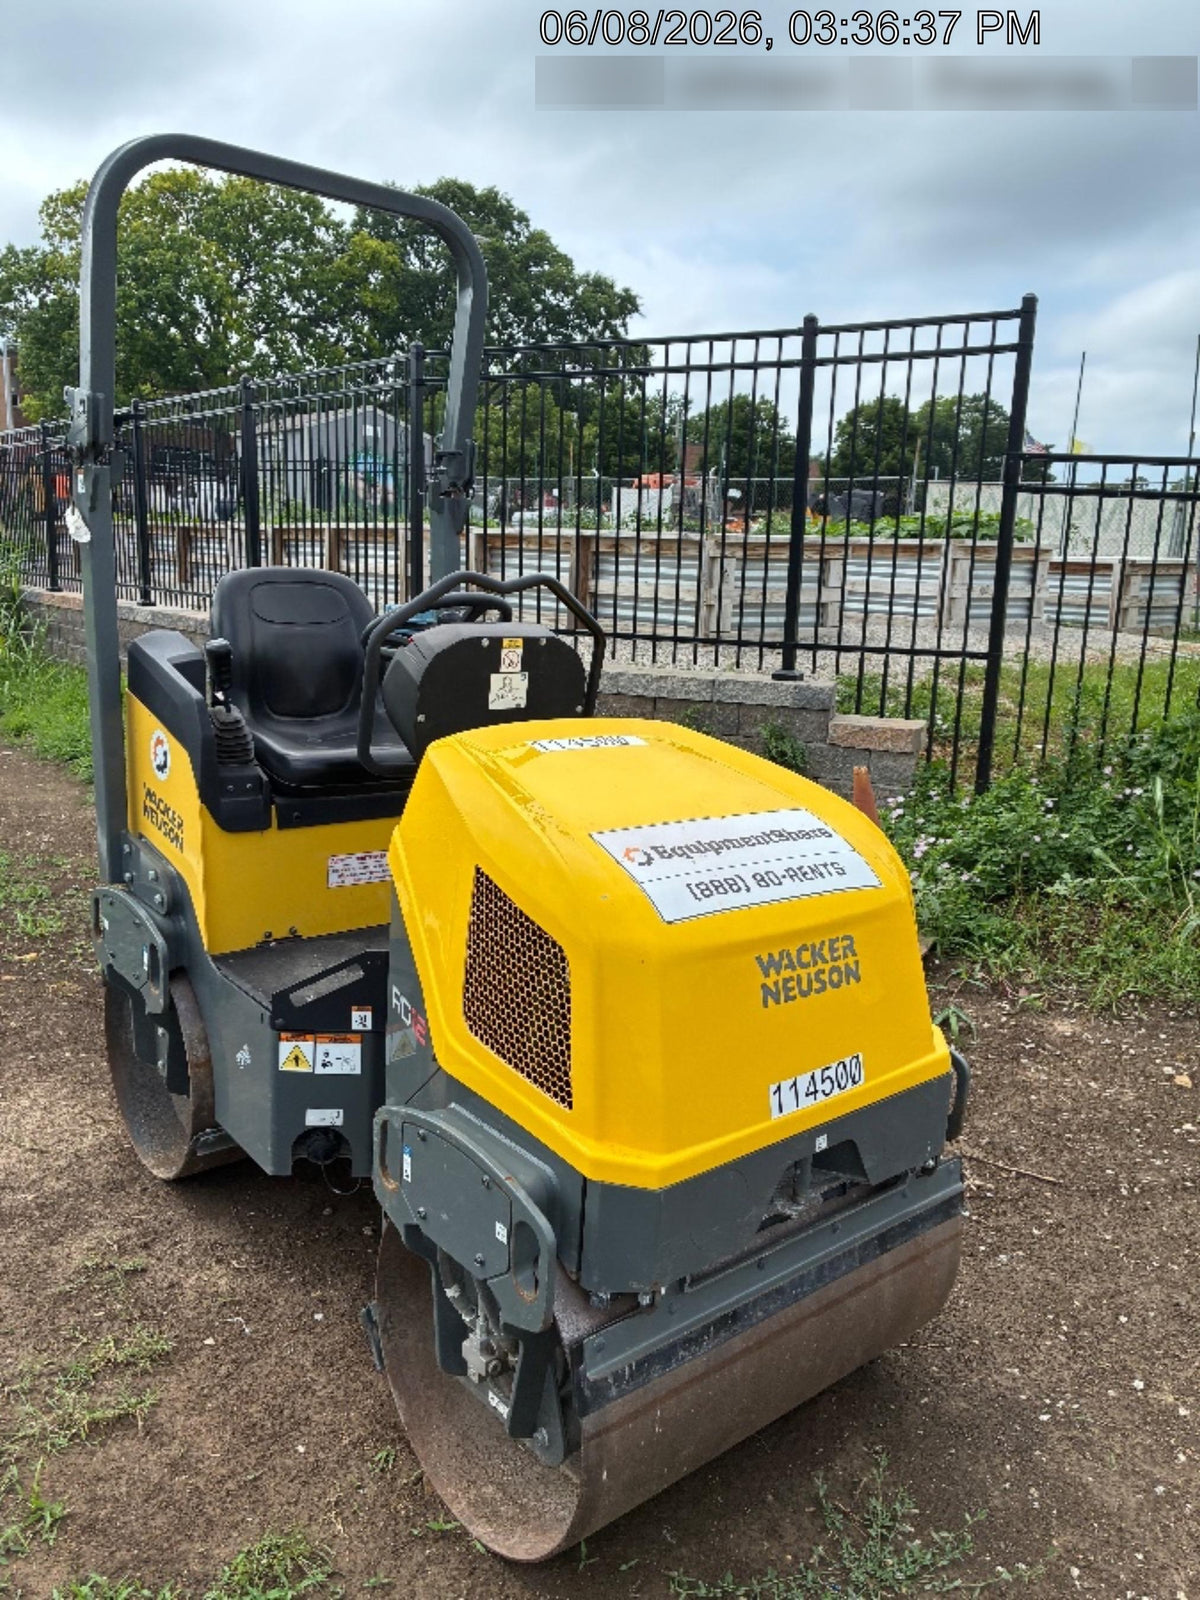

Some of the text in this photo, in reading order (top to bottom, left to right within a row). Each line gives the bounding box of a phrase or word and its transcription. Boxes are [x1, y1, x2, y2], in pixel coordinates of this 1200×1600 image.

[143, 781, 184, 835] WACKER
[143, 799, 184, 854] NEUSON
[650, 827, 834, 861] EquipmentShare
[685, 860, 847, 902] (888) 80-RENTS
[755, 934, 858, 979] WACKER
[760, 959, 862, 1009] NEUSON
[772, 1053, 863, 1114] 114500
